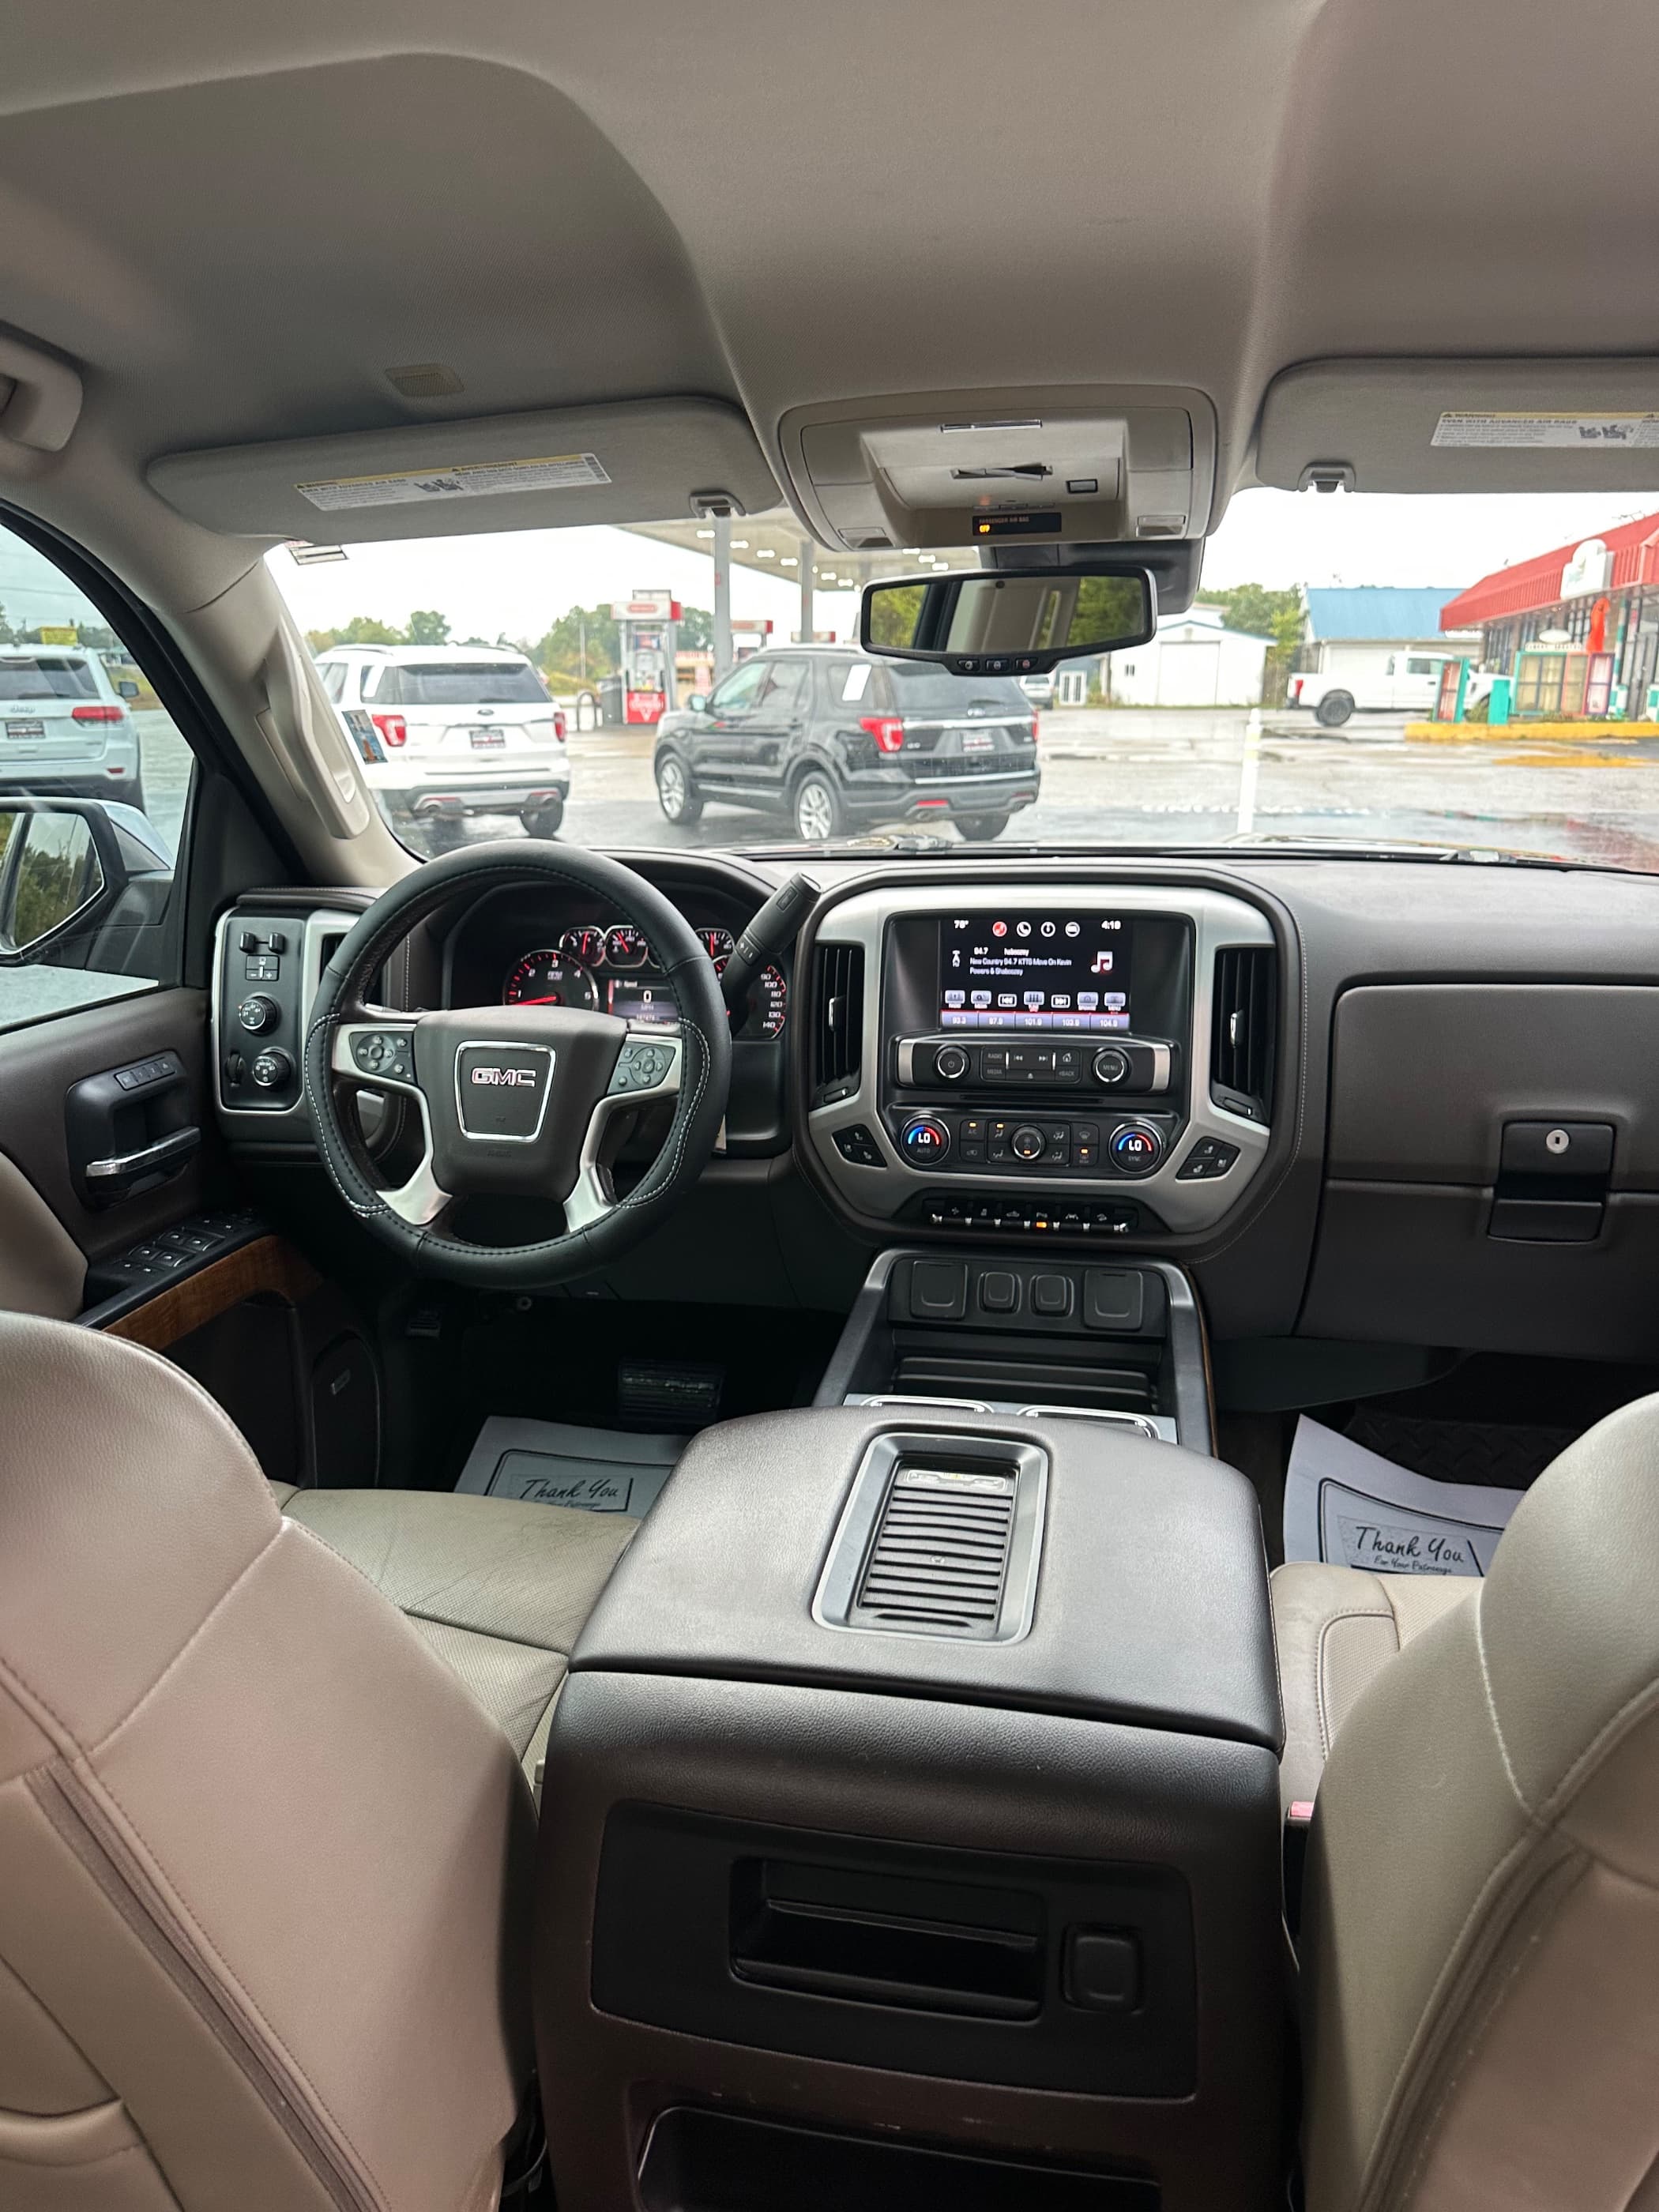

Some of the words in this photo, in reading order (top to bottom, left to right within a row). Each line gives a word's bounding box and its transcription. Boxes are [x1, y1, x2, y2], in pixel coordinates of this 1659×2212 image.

[643, 990, 652, 1003] 0
[472, 1067, 536, 1087] GMC
[918, 1132, 931, 1143] LO
[1128, 1139, 1142, 1151] LO
[519, 1478, 587, 1499] Thank
[589, 1478, 619, 1499] You
[1356, 1525, 1420, 1559] Thank
[1428, 1538, 1464, 1563] You
[1374, 1555, 1389, 1564] For
[1390, 1557, 1410, 1568] Your
